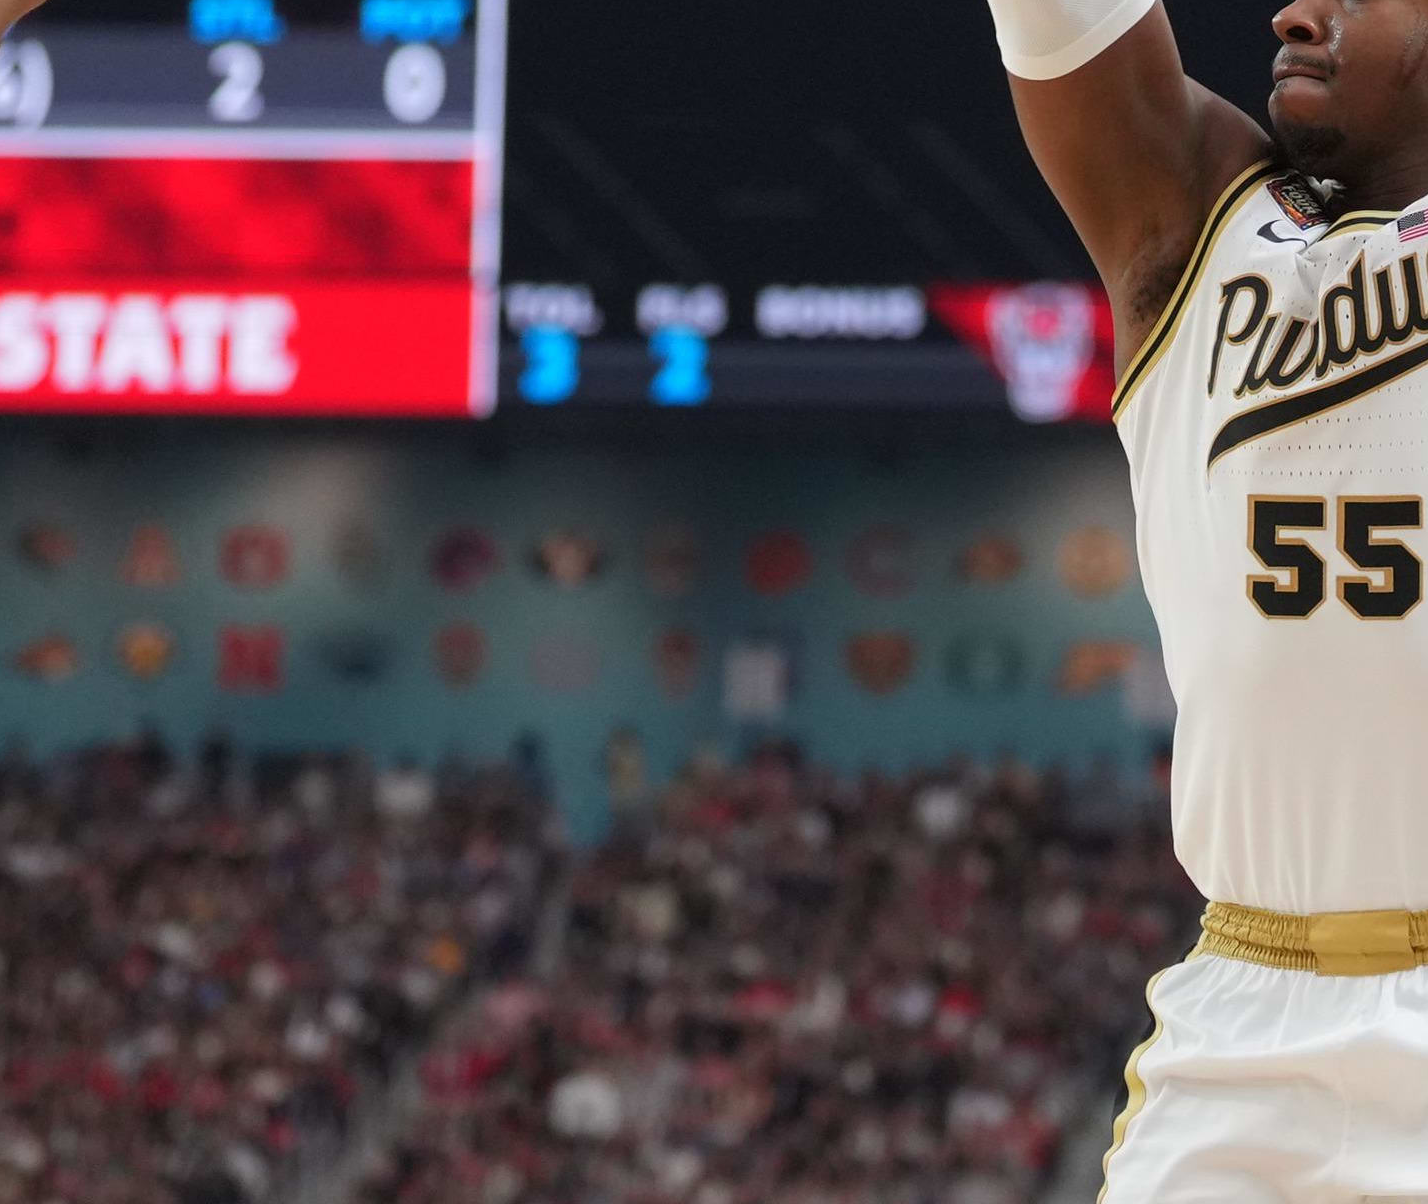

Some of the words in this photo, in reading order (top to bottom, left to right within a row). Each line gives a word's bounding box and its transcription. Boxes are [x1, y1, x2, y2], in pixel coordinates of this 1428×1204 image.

[208, 41, 264, 122] 2
[382, 43, 446, 123] 0
[517, 324, 580, 406] 3
[649, 323, 711, 406] 2
[1246, 494, 1423, 620] 55
